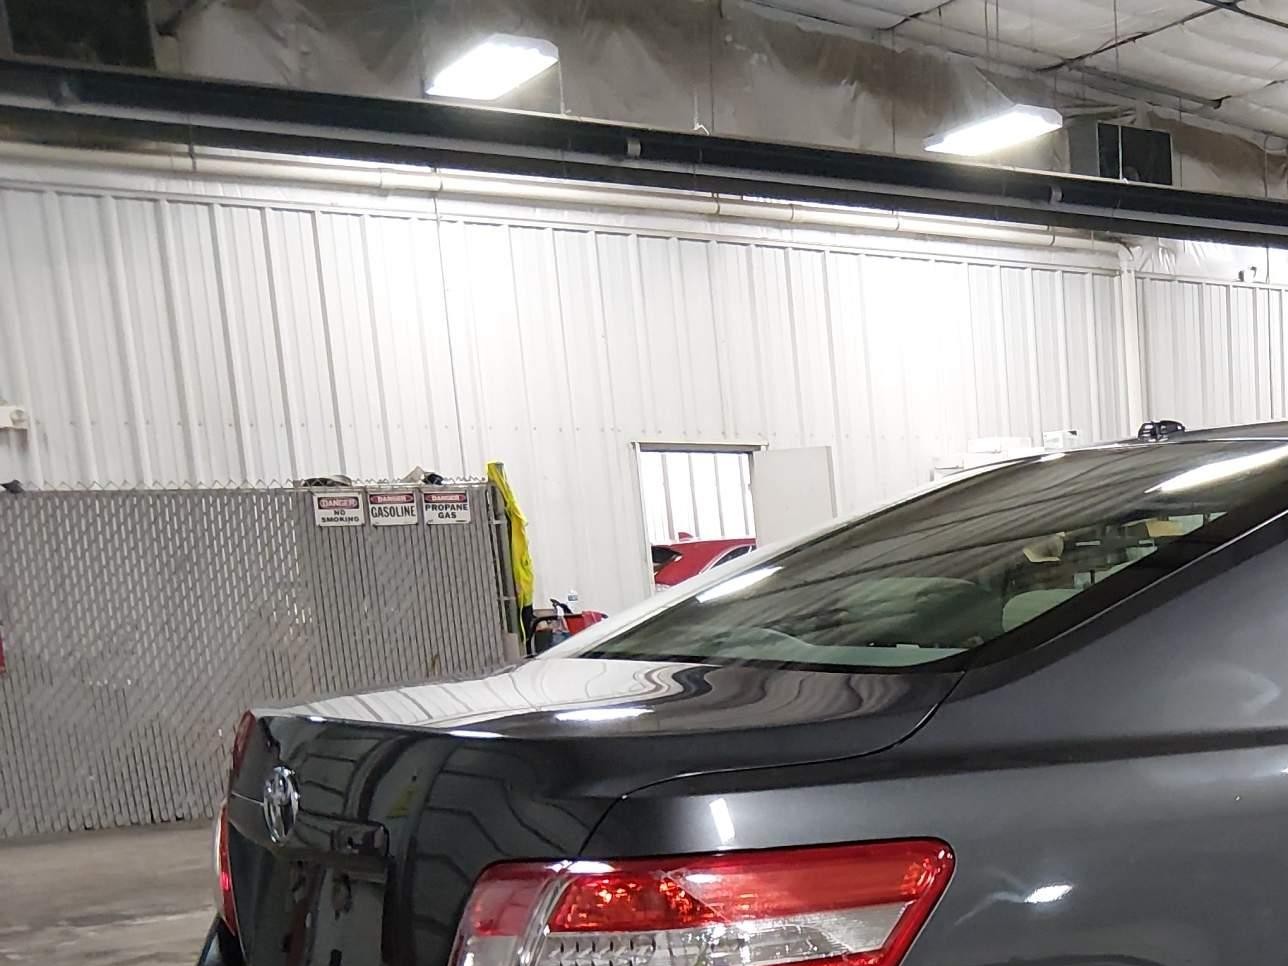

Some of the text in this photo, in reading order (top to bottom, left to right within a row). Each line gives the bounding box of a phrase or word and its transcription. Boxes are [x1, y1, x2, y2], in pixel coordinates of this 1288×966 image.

[377, 495, 407, 503] DANGER
[431, 494, 460, 502] DANGER
[321, 498, 358, 508] DANGER
[425, 503, 469, 512] PROPANE
[371, 505, 416, 518] GASOLINE
